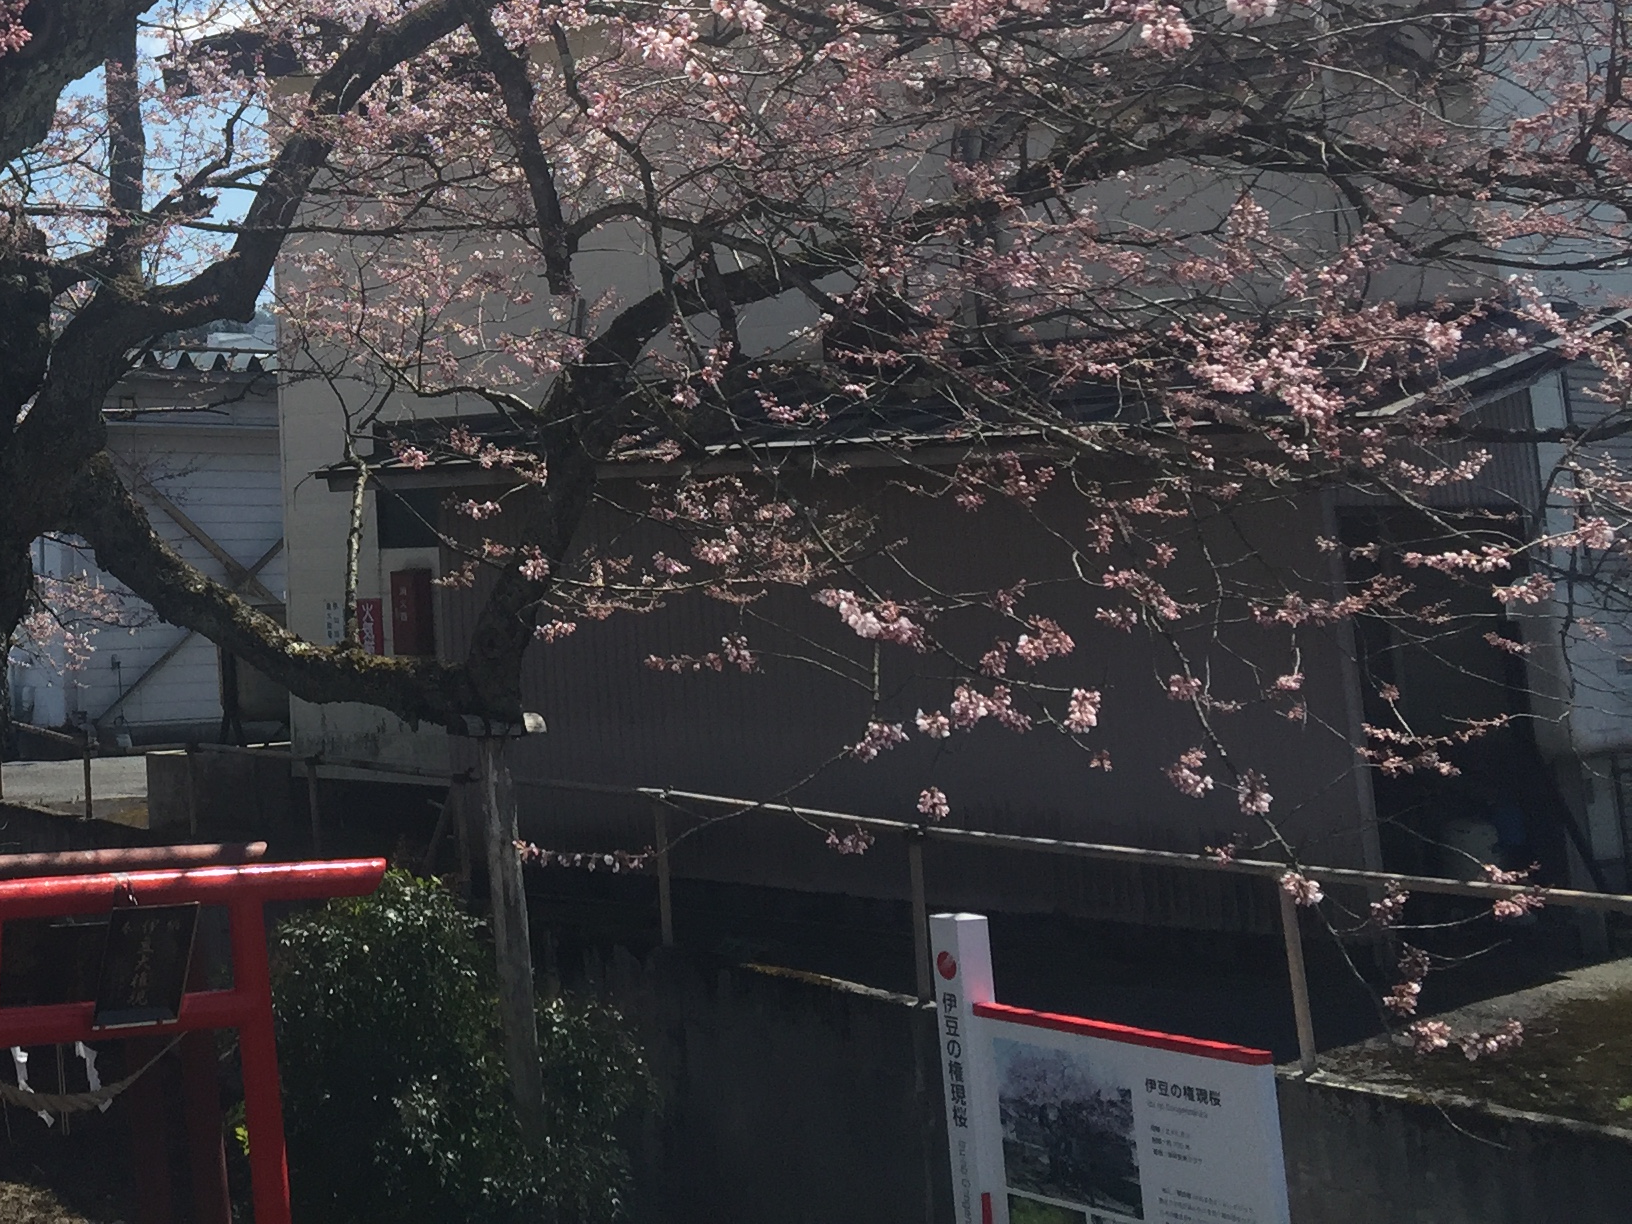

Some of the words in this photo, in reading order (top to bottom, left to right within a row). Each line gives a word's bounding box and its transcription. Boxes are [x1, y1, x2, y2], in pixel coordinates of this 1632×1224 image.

[942, 992, 968, 1128] 伊豆の権現桜
[1144, 1077, 1222, 1107] 伊豆の権現桜
